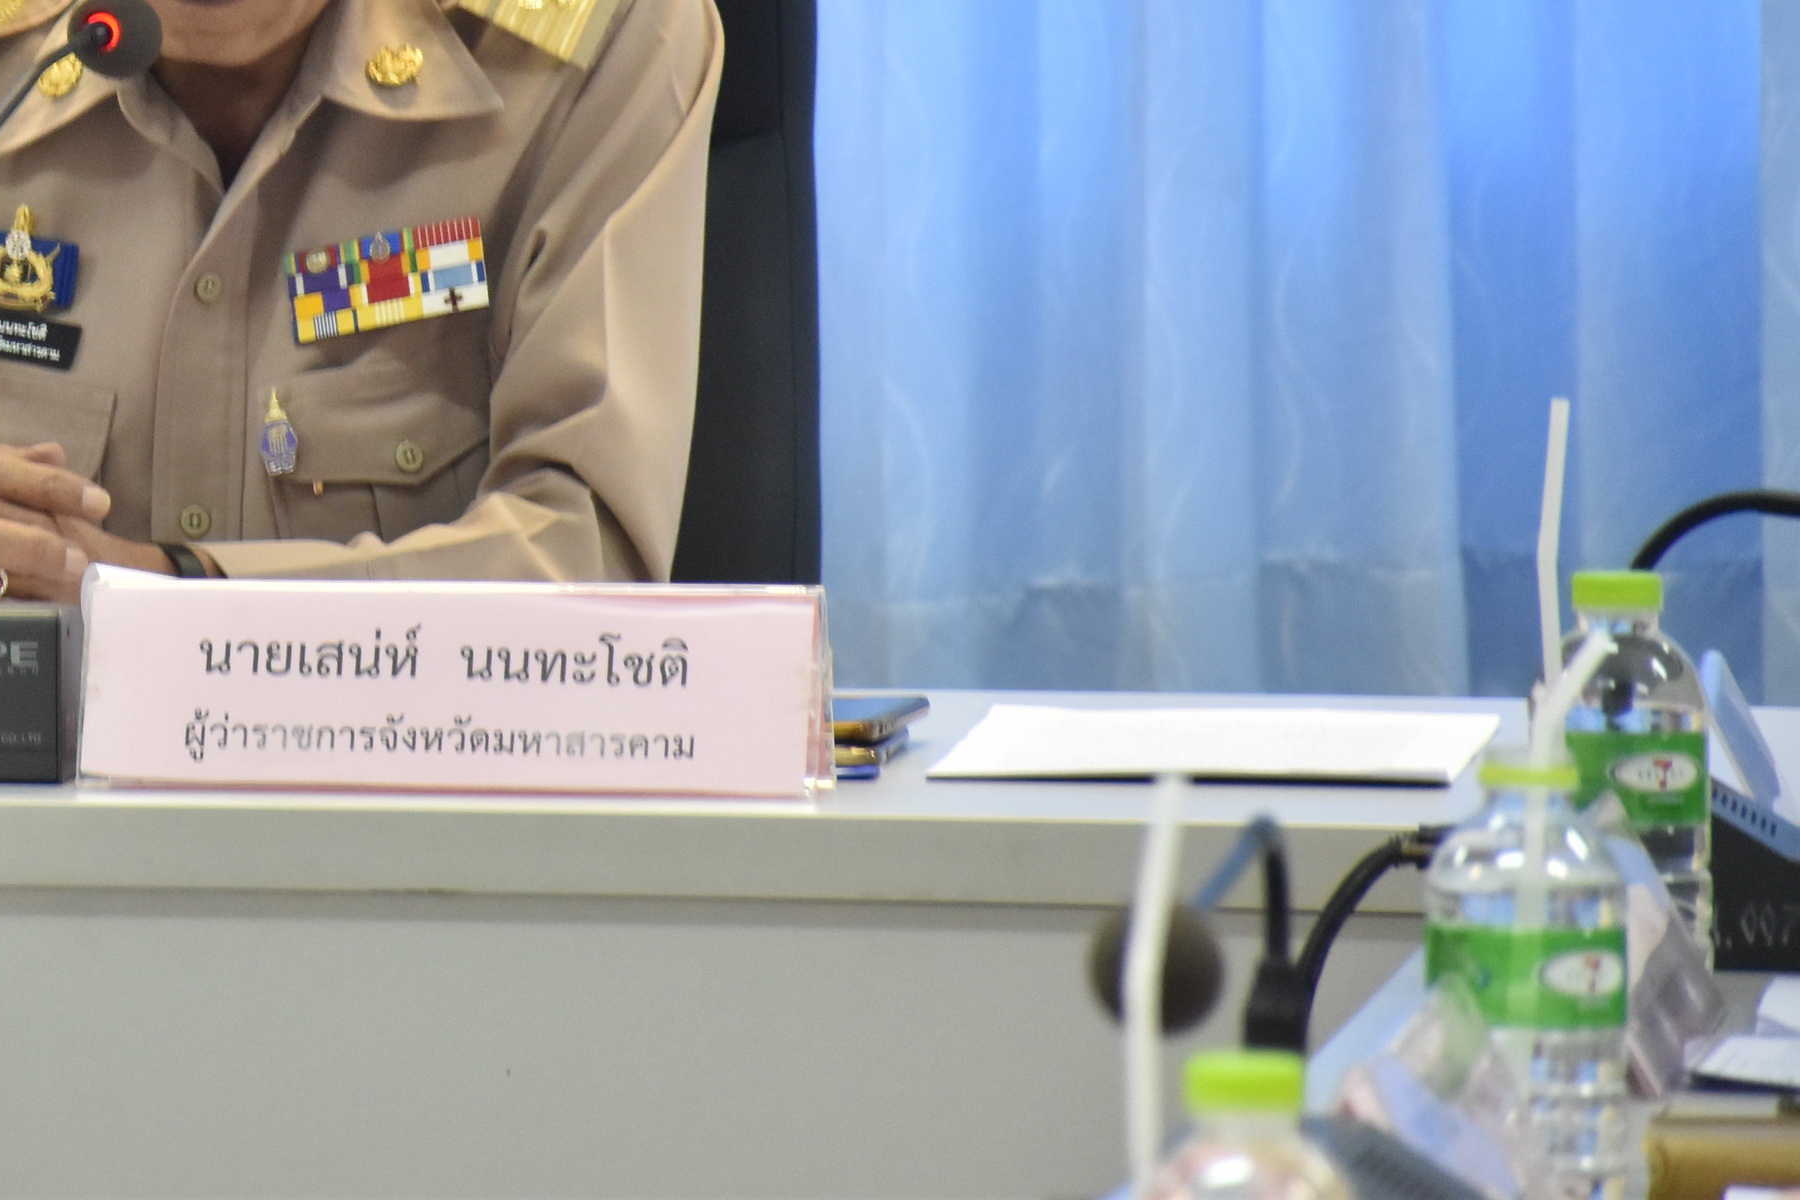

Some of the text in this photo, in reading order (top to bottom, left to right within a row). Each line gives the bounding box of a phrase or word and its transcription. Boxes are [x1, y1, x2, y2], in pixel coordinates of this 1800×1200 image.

[199, 623, 689, 688] นายเสน่ห์ นนทะโชติ
[184, 706, 695, 762] ผู้ว่าราชการจังหวัดมหาสารคาม
